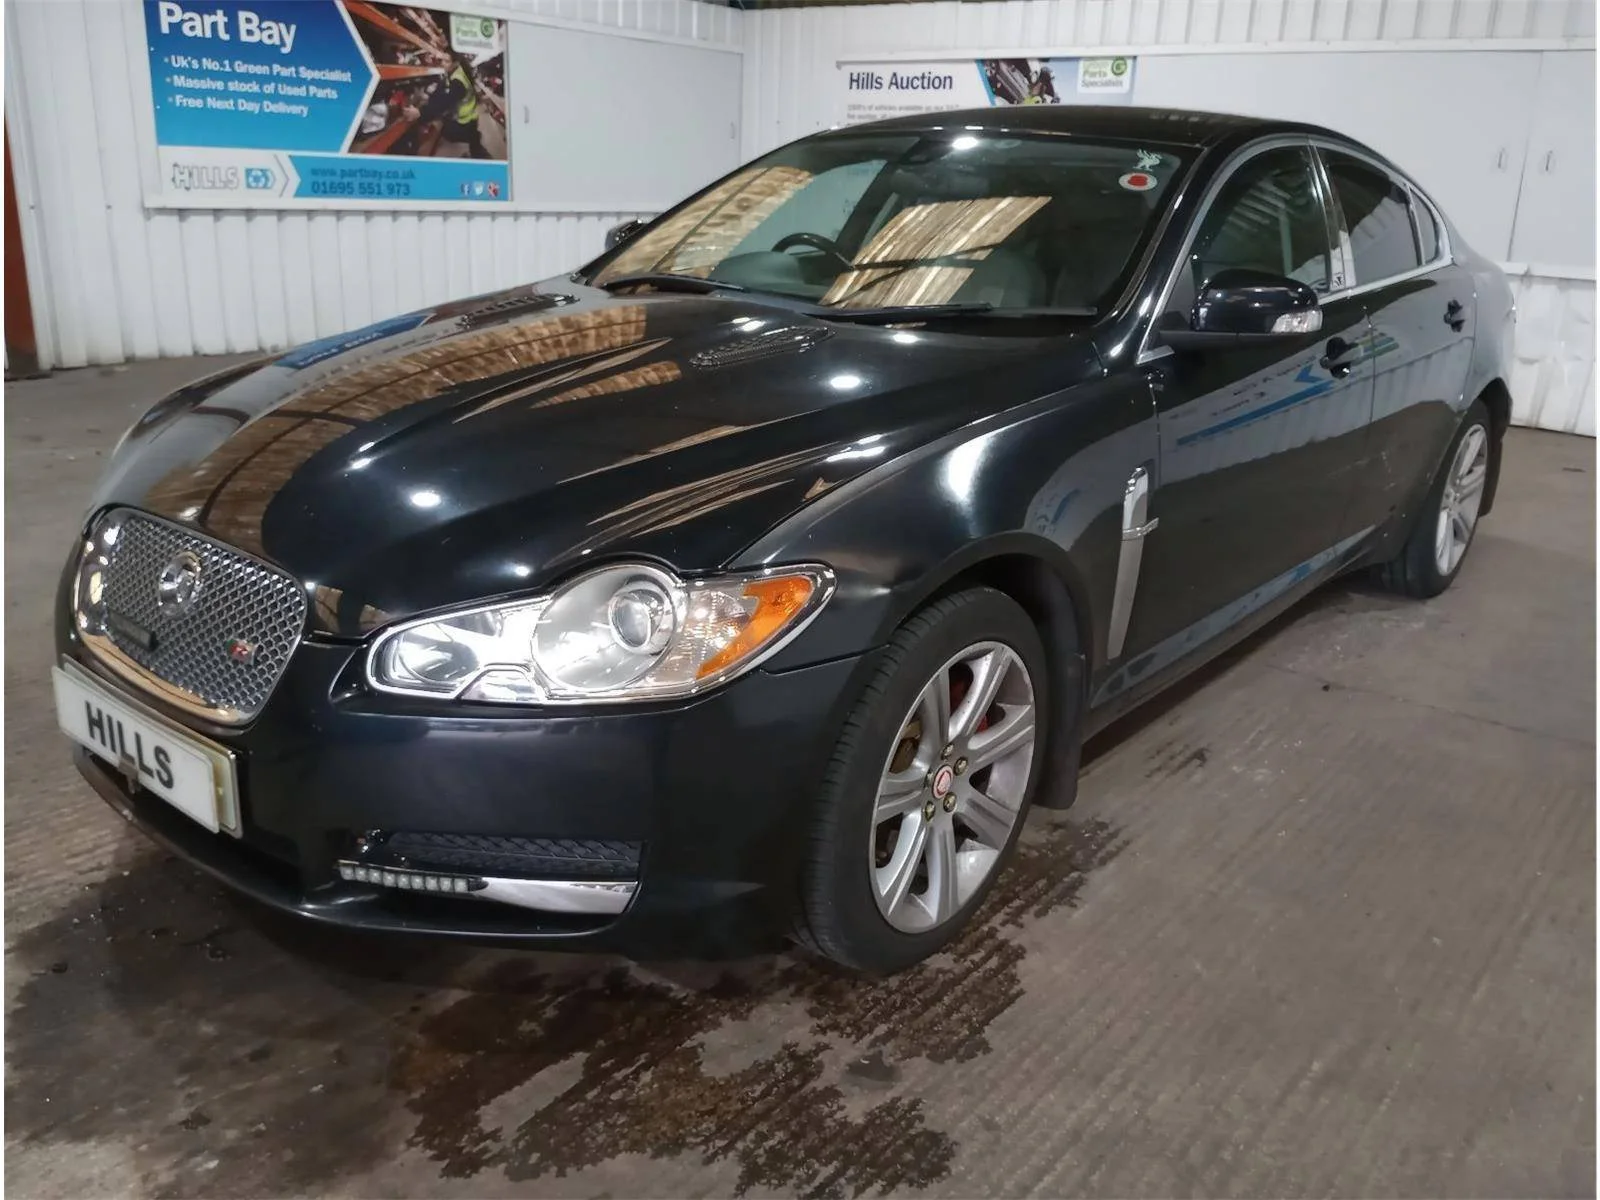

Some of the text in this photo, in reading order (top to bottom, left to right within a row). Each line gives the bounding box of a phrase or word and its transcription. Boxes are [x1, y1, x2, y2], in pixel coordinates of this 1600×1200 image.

[158, 1, 297, 54] Part Bay
[171, 55, 200, 70] Uk's
[202, 57, 232, 72] No.1
[234, 60, 270, 75] Green
[272, 63, 297, 78] Part
[173, 74, 338, 100] Massive stock of Used Parts
[849, 71, 953, 90] Hills Auction
[175, 94, 309, 118] Free Next Day Delivery
[172, 163, 240, 191] HILLS
[310, 167, 416, 181] www.partbay.co.uk
[311, 181, 411, 197] 01695 551 973
[85, 700, 174, 790] HILLS
